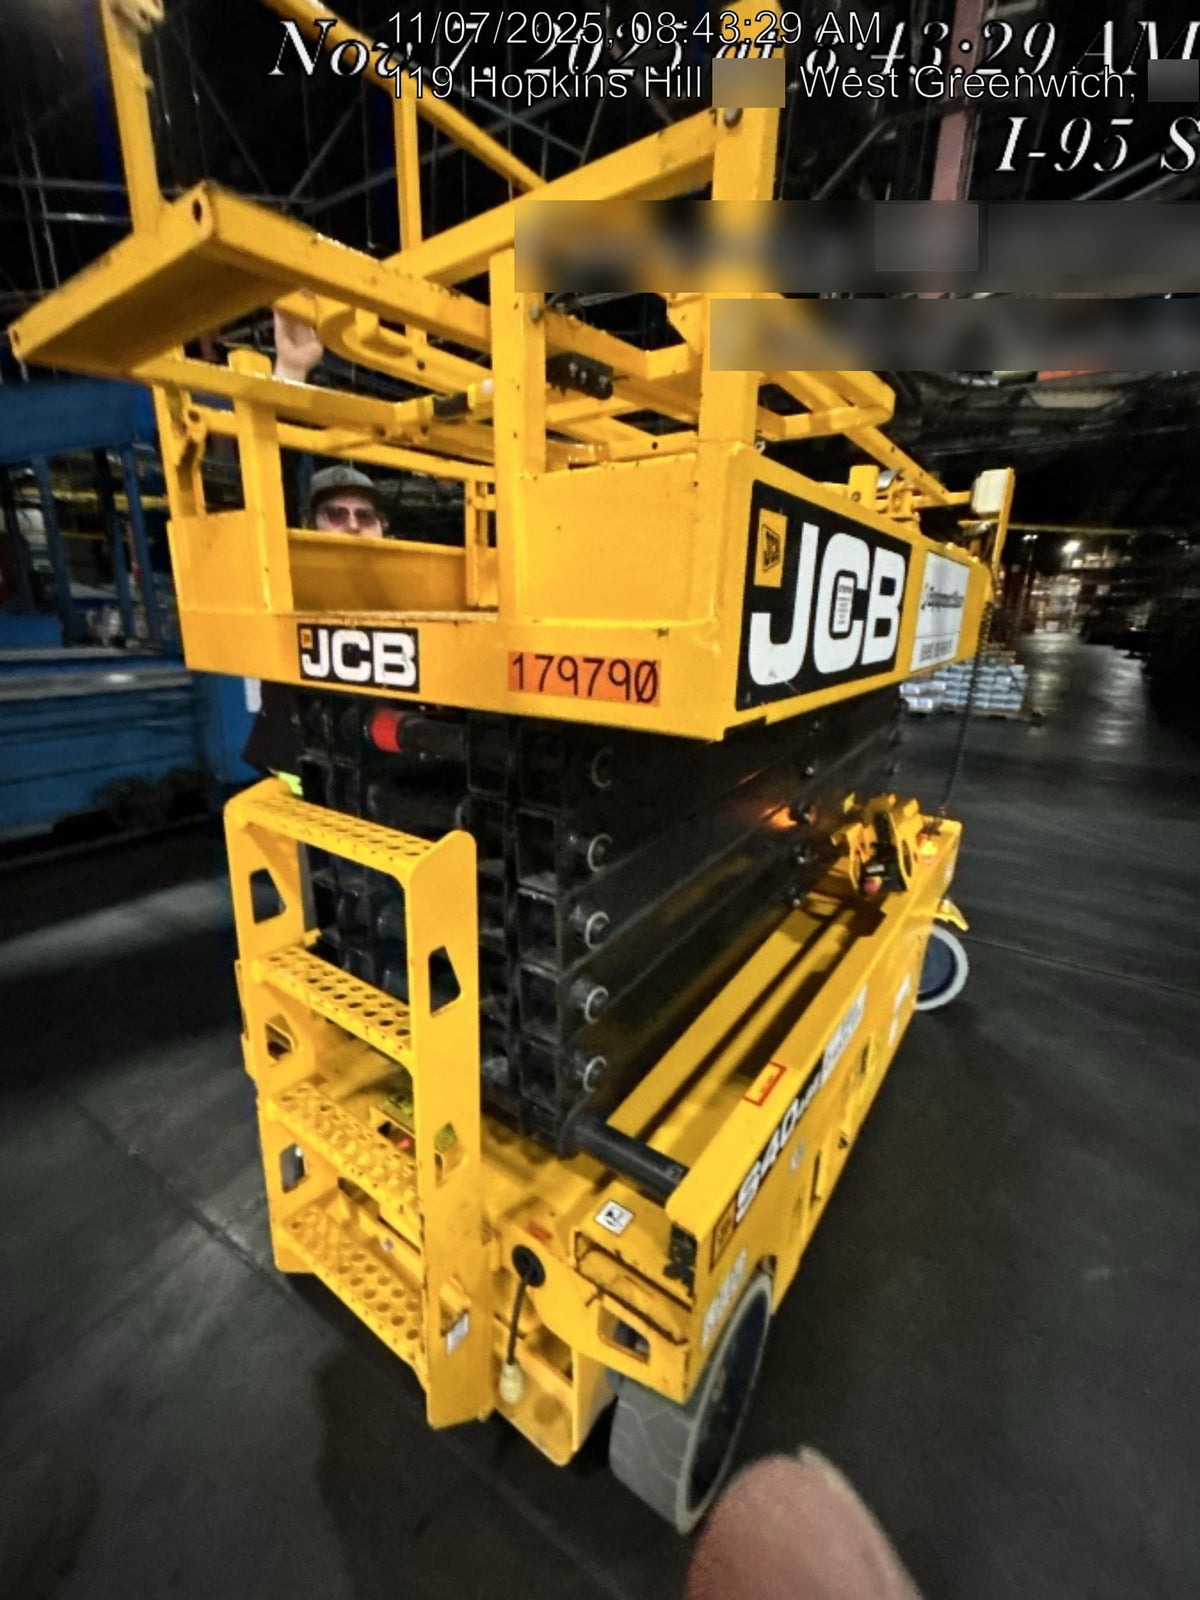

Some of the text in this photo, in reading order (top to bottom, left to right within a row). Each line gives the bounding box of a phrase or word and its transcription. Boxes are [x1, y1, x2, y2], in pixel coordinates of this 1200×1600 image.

[748, 522, 906, 686] JCB
[301, 628, 418, 688] JCB
[511, 652, 660, 704] 179790
